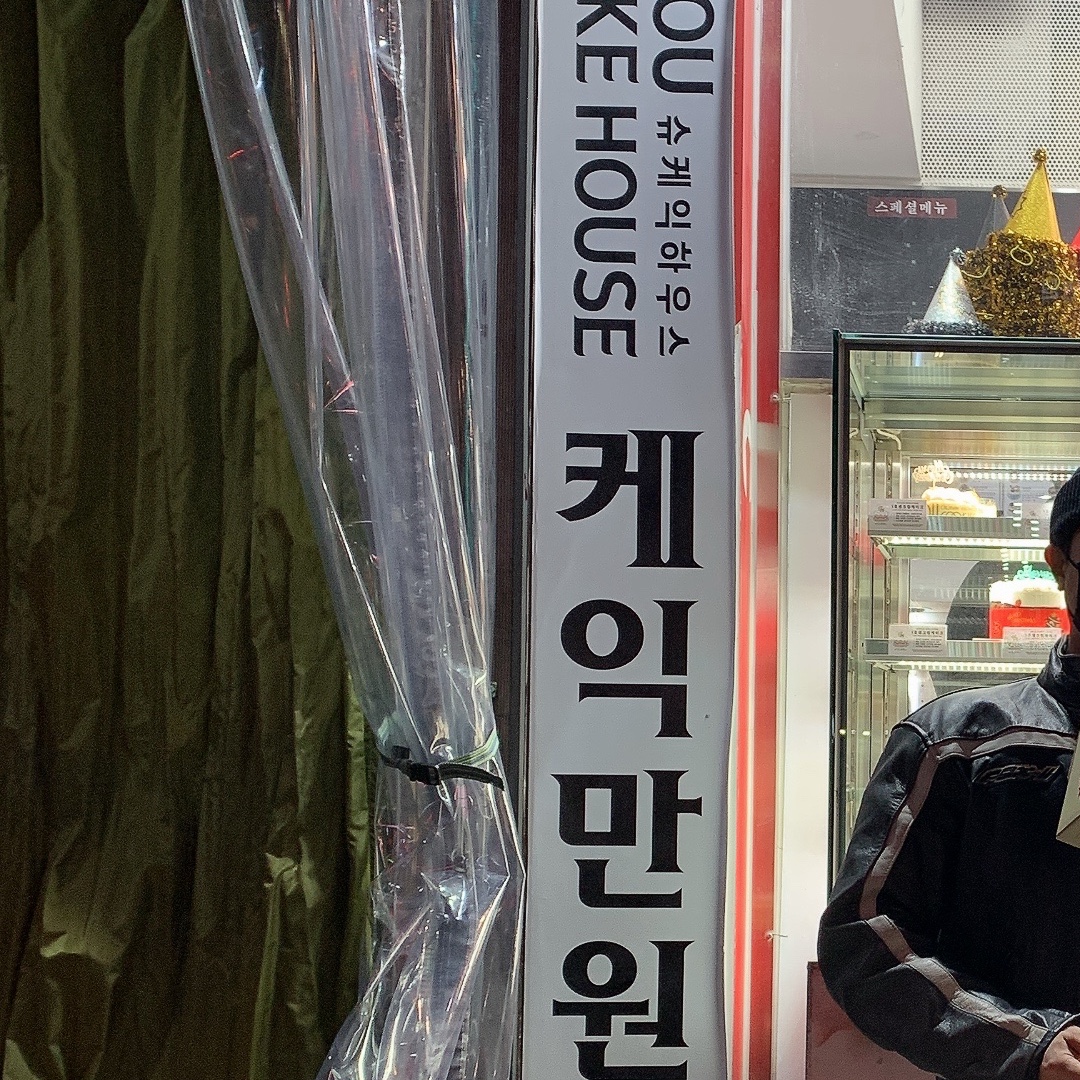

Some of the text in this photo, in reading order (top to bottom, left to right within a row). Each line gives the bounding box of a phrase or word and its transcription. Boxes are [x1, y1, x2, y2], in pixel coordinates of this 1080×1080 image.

[572, 105, 639, 357] HOUSE
[655, 115, 692, 357] 슈케익하우스
[874, 199, 948, 216] 스페셜메뉴
